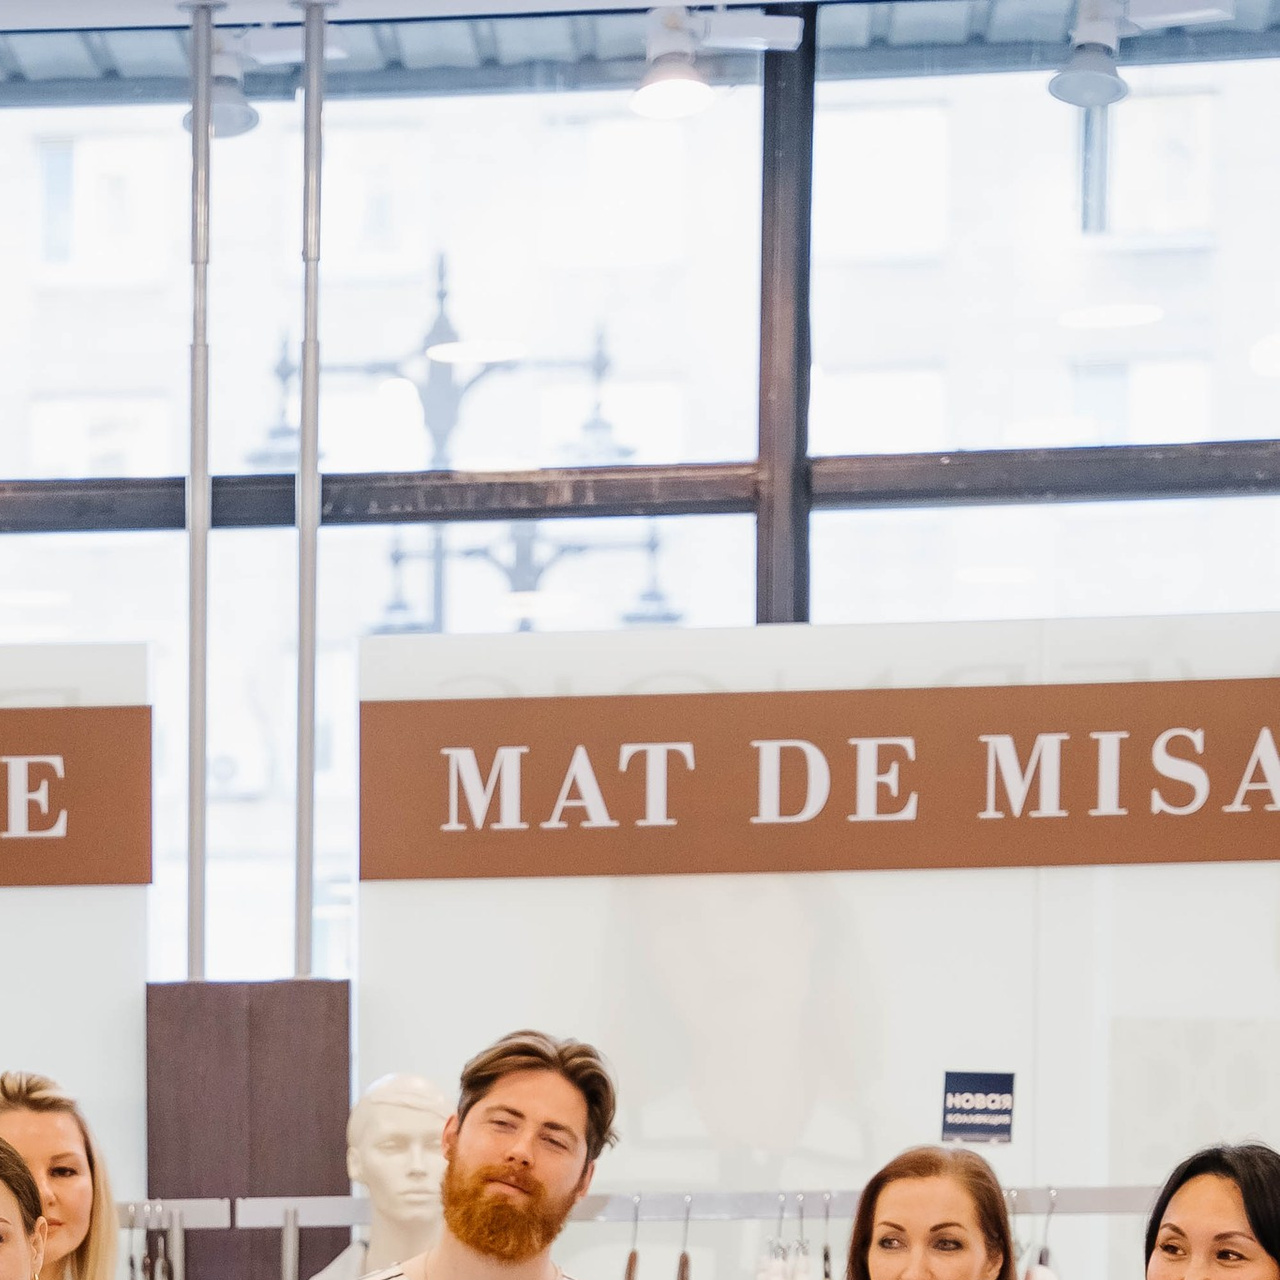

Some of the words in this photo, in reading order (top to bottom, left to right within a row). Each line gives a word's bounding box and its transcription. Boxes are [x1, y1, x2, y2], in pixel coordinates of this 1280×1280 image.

[440, 741, 695, 831] MAT
[749, 736, 918, 824] DE
[978, 726, 1280, 819] MISA
